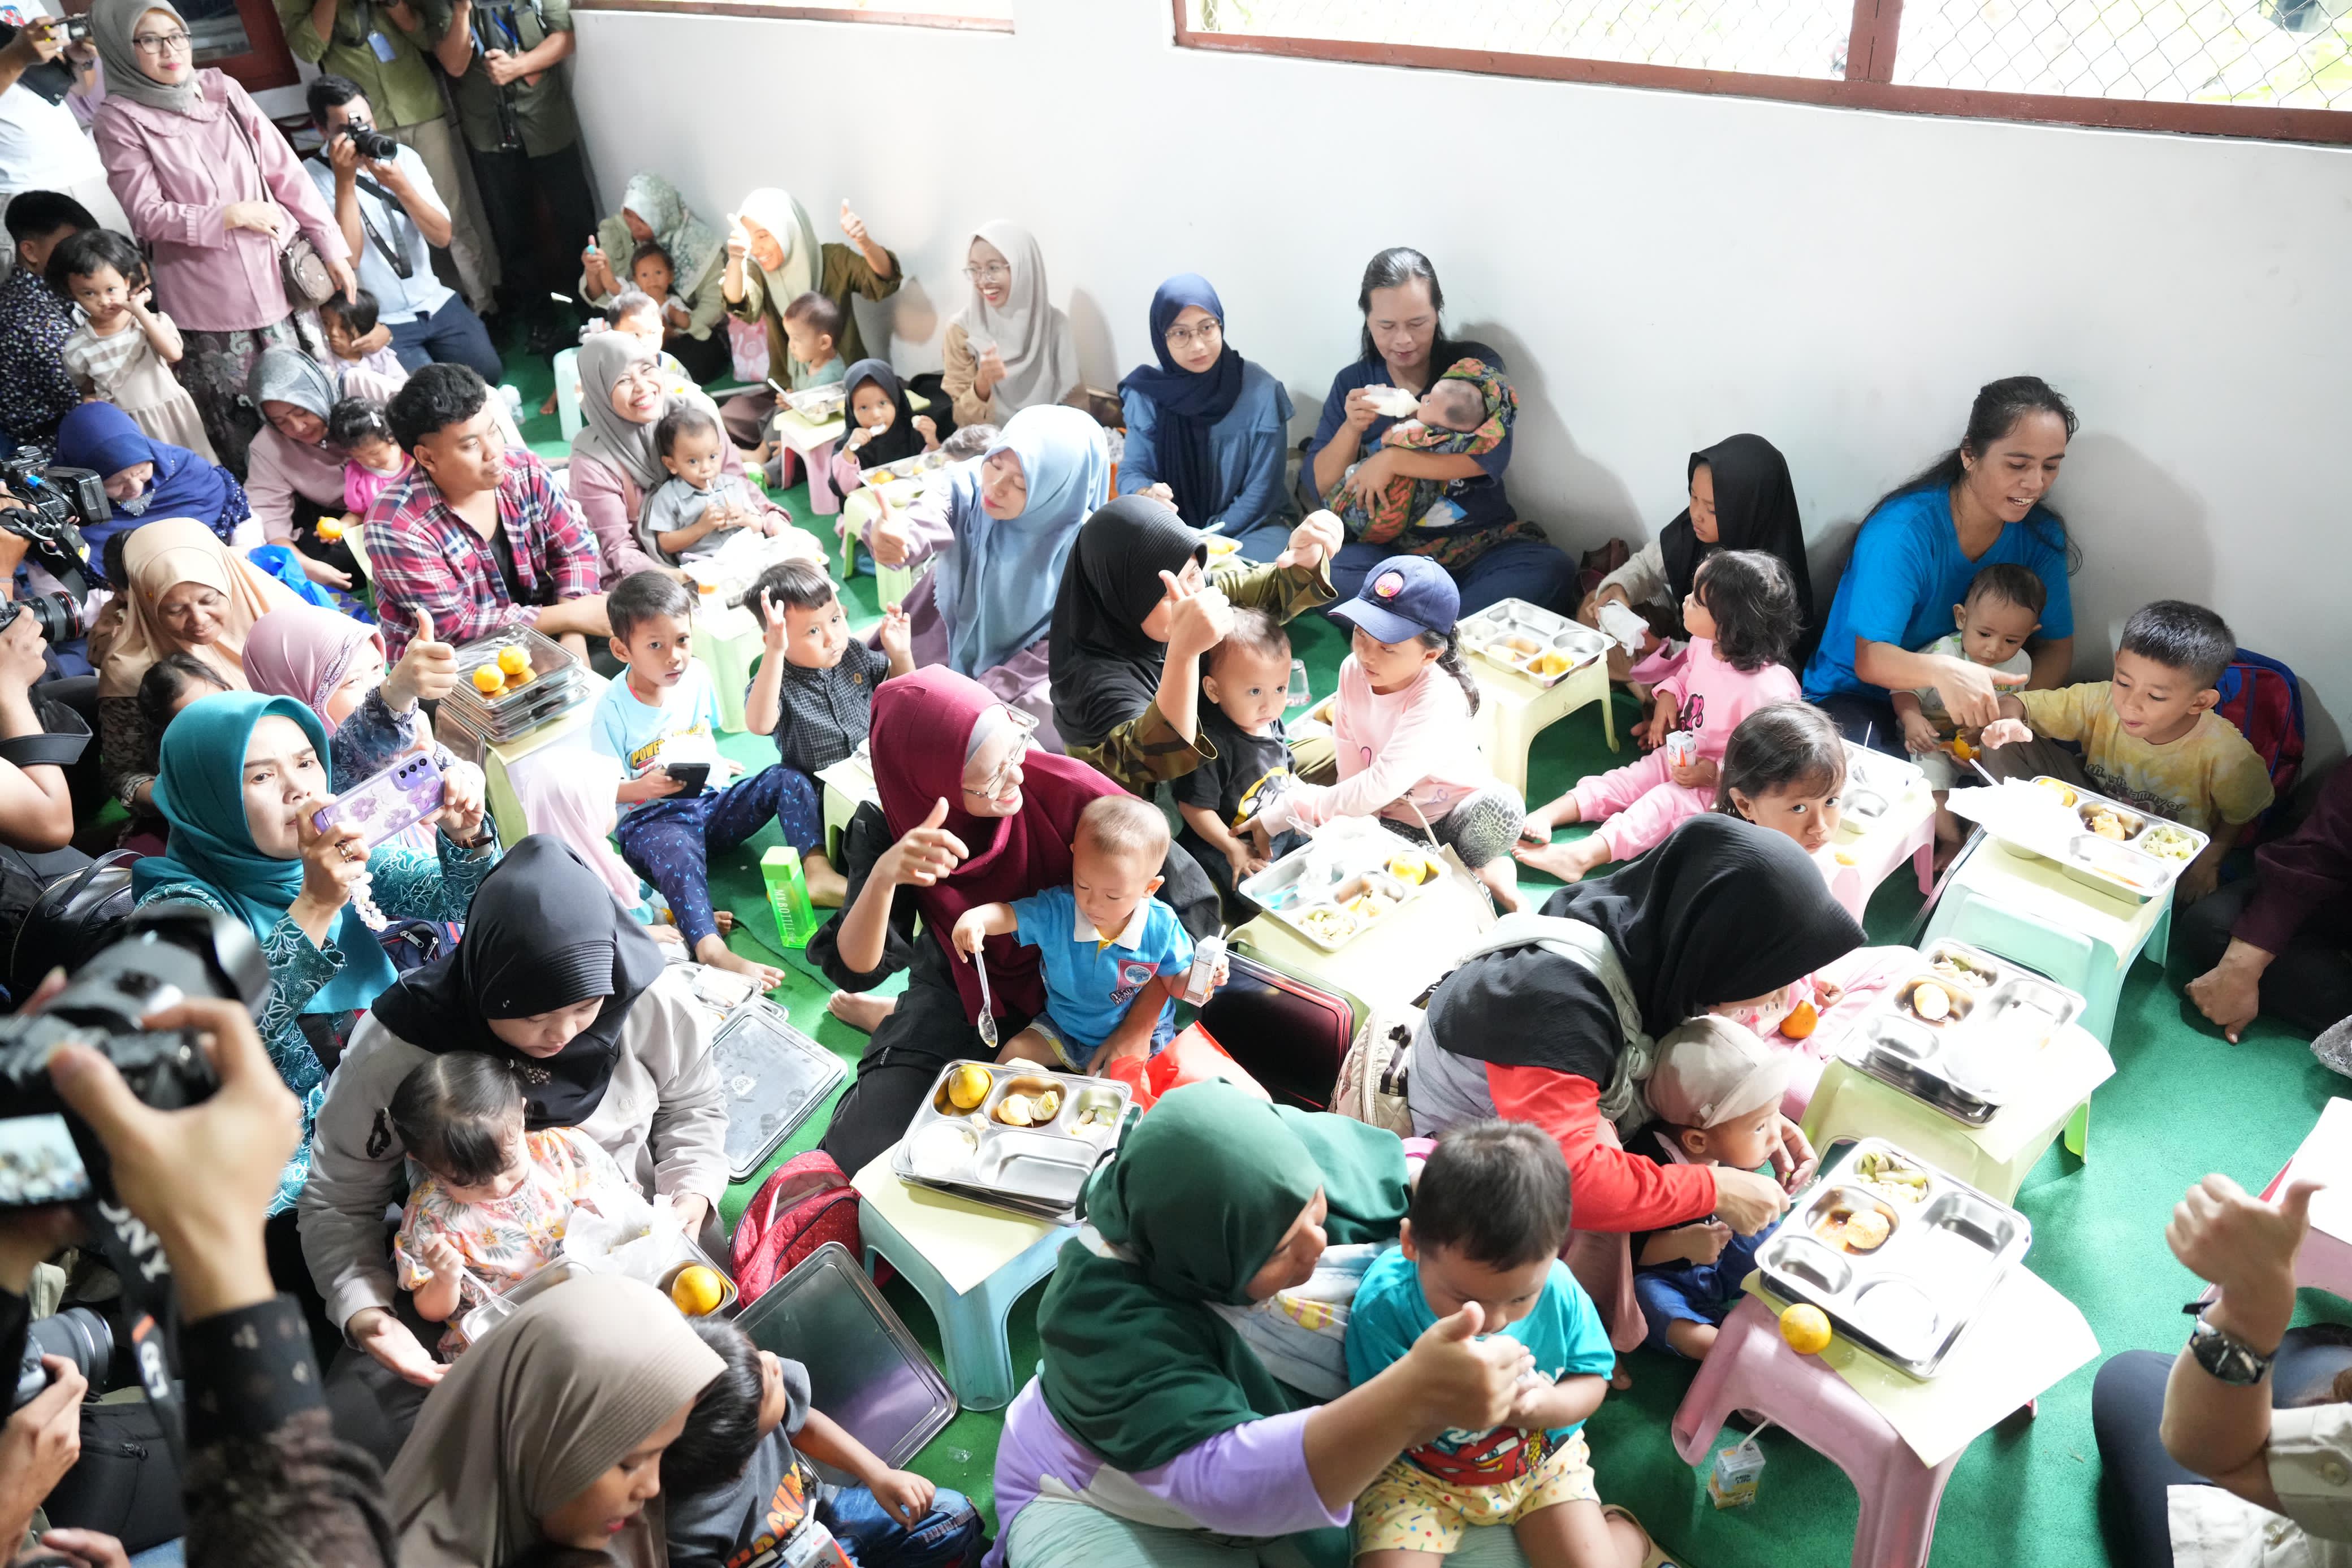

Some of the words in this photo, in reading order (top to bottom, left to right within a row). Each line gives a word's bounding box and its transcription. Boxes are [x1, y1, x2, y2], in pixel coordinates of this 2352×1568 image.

[630, 738, 665, 768] POWE
[773, 889, 786, 901] MY
[777, 902, 795, 932] BOTTLE
[97, 1198, 171, 1283] NY
